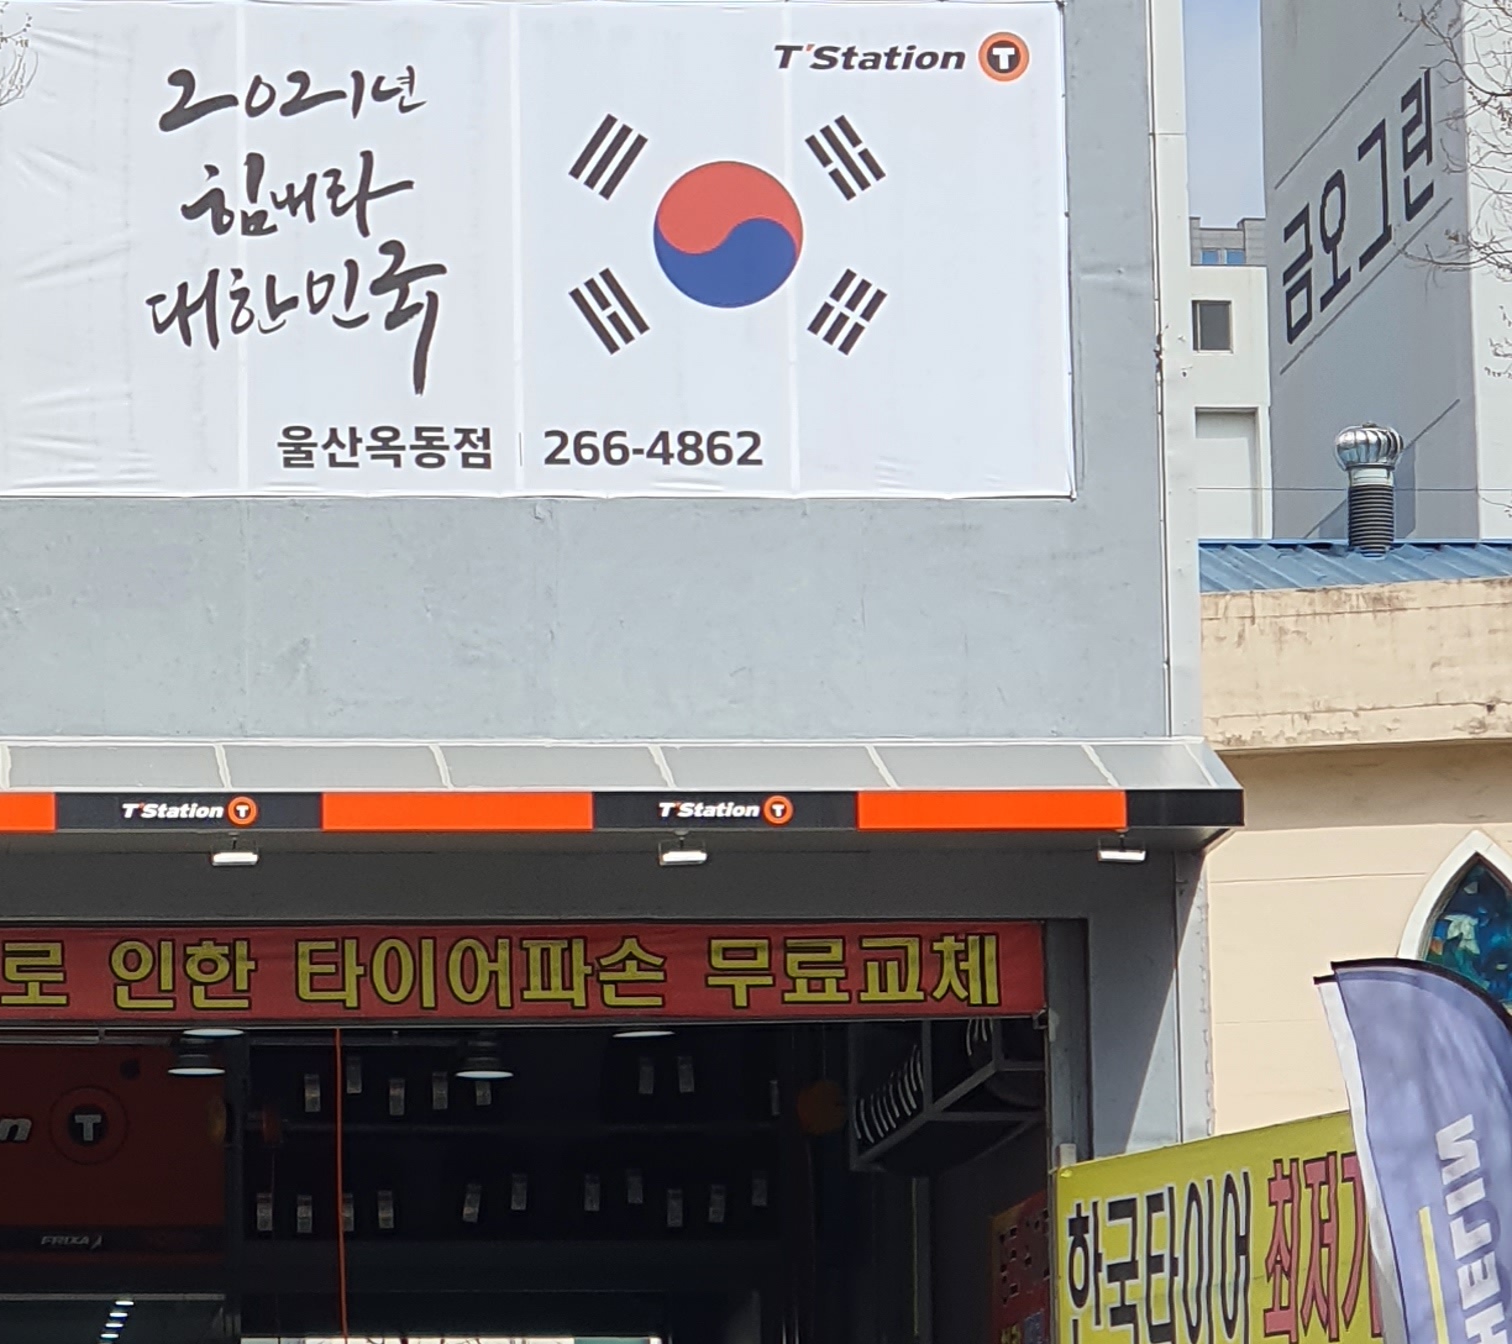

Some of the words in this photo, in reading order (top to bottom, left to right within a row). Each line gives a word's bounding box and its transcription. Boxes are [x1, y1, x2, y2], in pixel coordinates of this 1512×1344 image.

[159, 65, 428, 133] 2021년
[181, 150, 414, 238] 힘내라
[145, 239, 448, 395] 대한민국
[277, 425, 492, 469] 울산옥동점
[544, 430, 763, 467] 266-4862
[110, 940, 256, 1009] 인한
[296, 938, 665, 1009] 타이어파손
[706, 936, 1000, 1008] 무료교체
